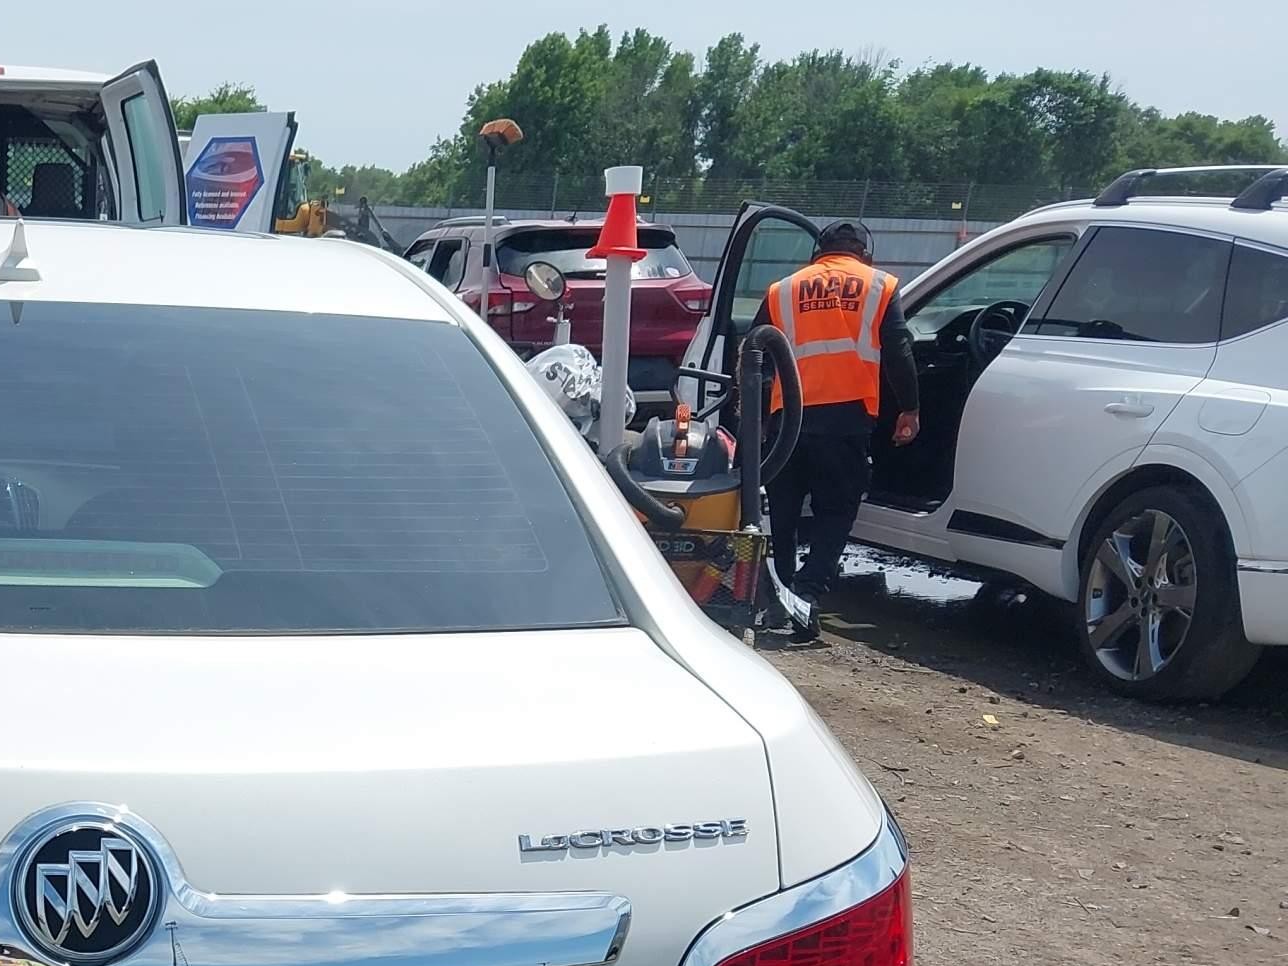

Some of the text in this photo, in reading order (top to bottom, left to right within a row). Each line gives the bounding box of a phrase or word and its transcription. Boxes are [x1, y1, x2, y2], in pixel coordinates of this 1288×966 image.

[192, 190, 202, 198] Fully
[799, 277, 864, 301] MAD
[802, 300, 855, 310] SERVICES
